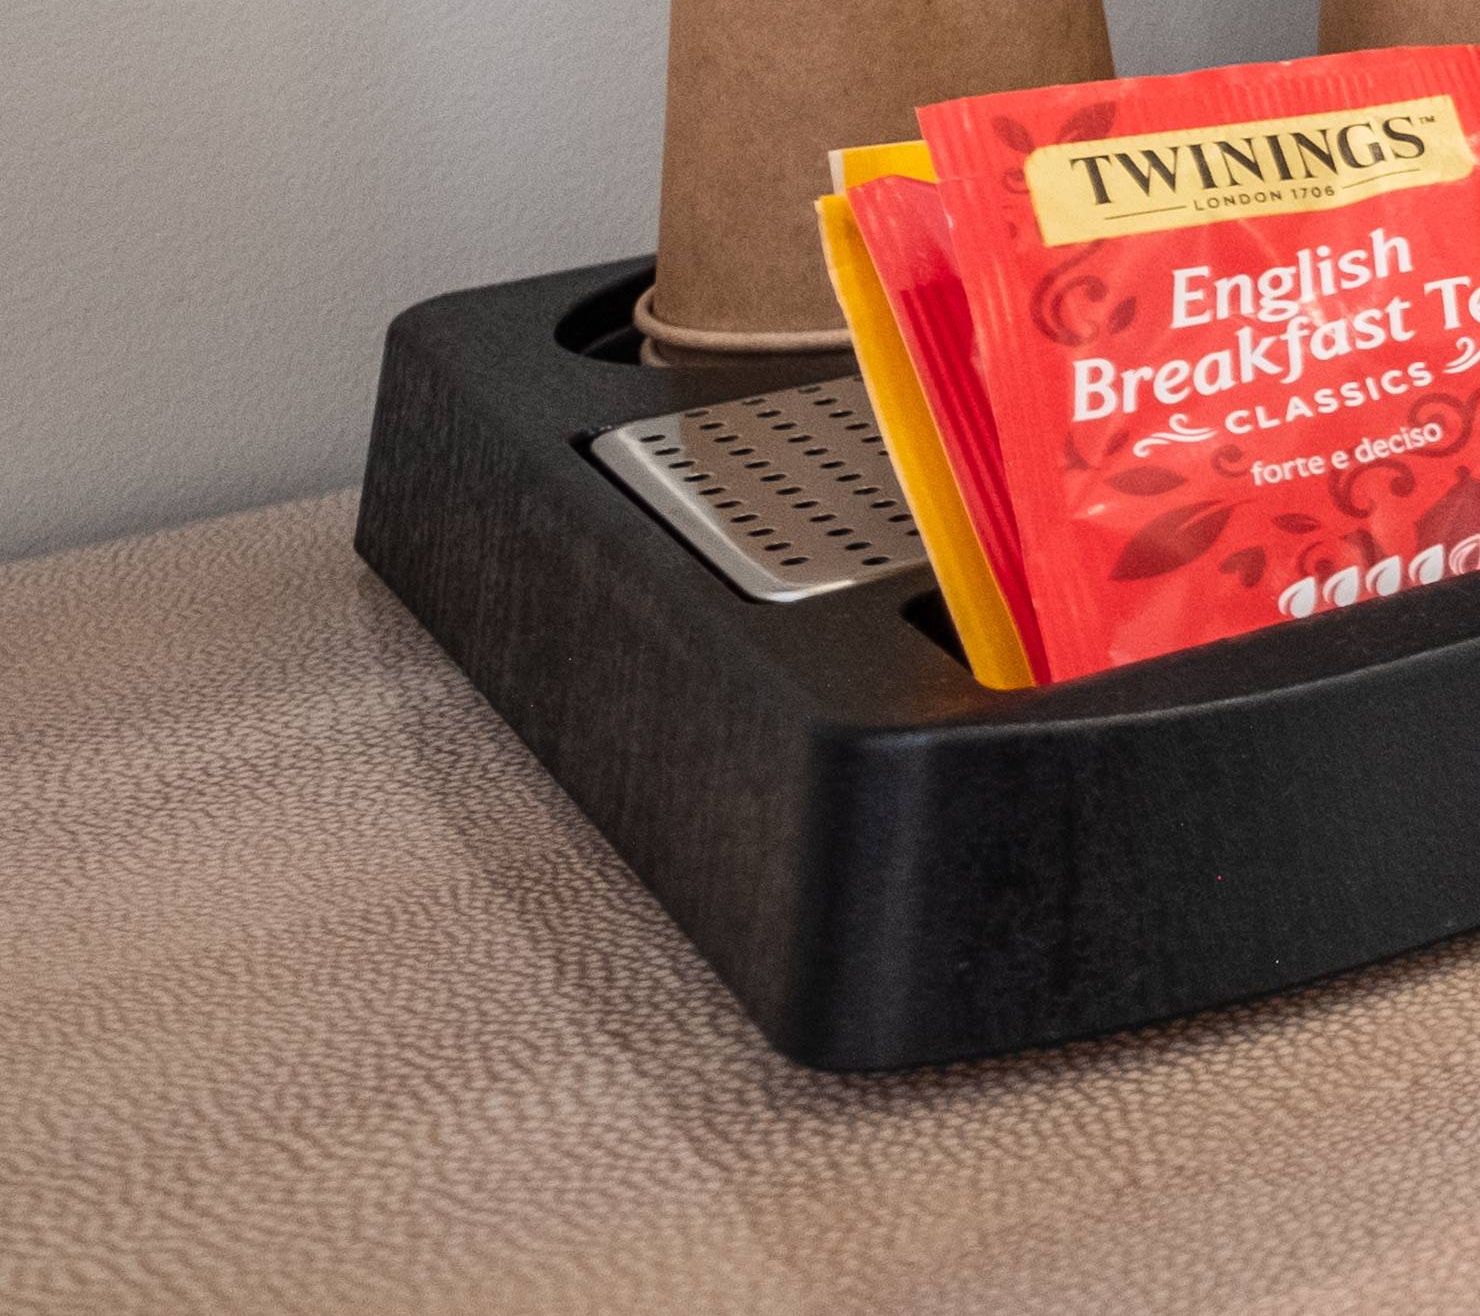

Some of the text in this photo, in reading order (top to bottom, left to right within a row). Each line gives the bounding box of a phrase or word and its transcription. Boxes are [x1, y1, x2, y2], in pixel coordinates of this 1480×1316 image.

[1070, 116, 1425, 206] TWININGS
[1193, 184, 1336, 211] LONDON 1706
[1170, 228, 1413, 329] English
[1072, 296, 1416, 422] Breakfast
[1224, 361, 1433, 434] CLASSICS
[1250, 422, 1444, 485] forte e deciso
